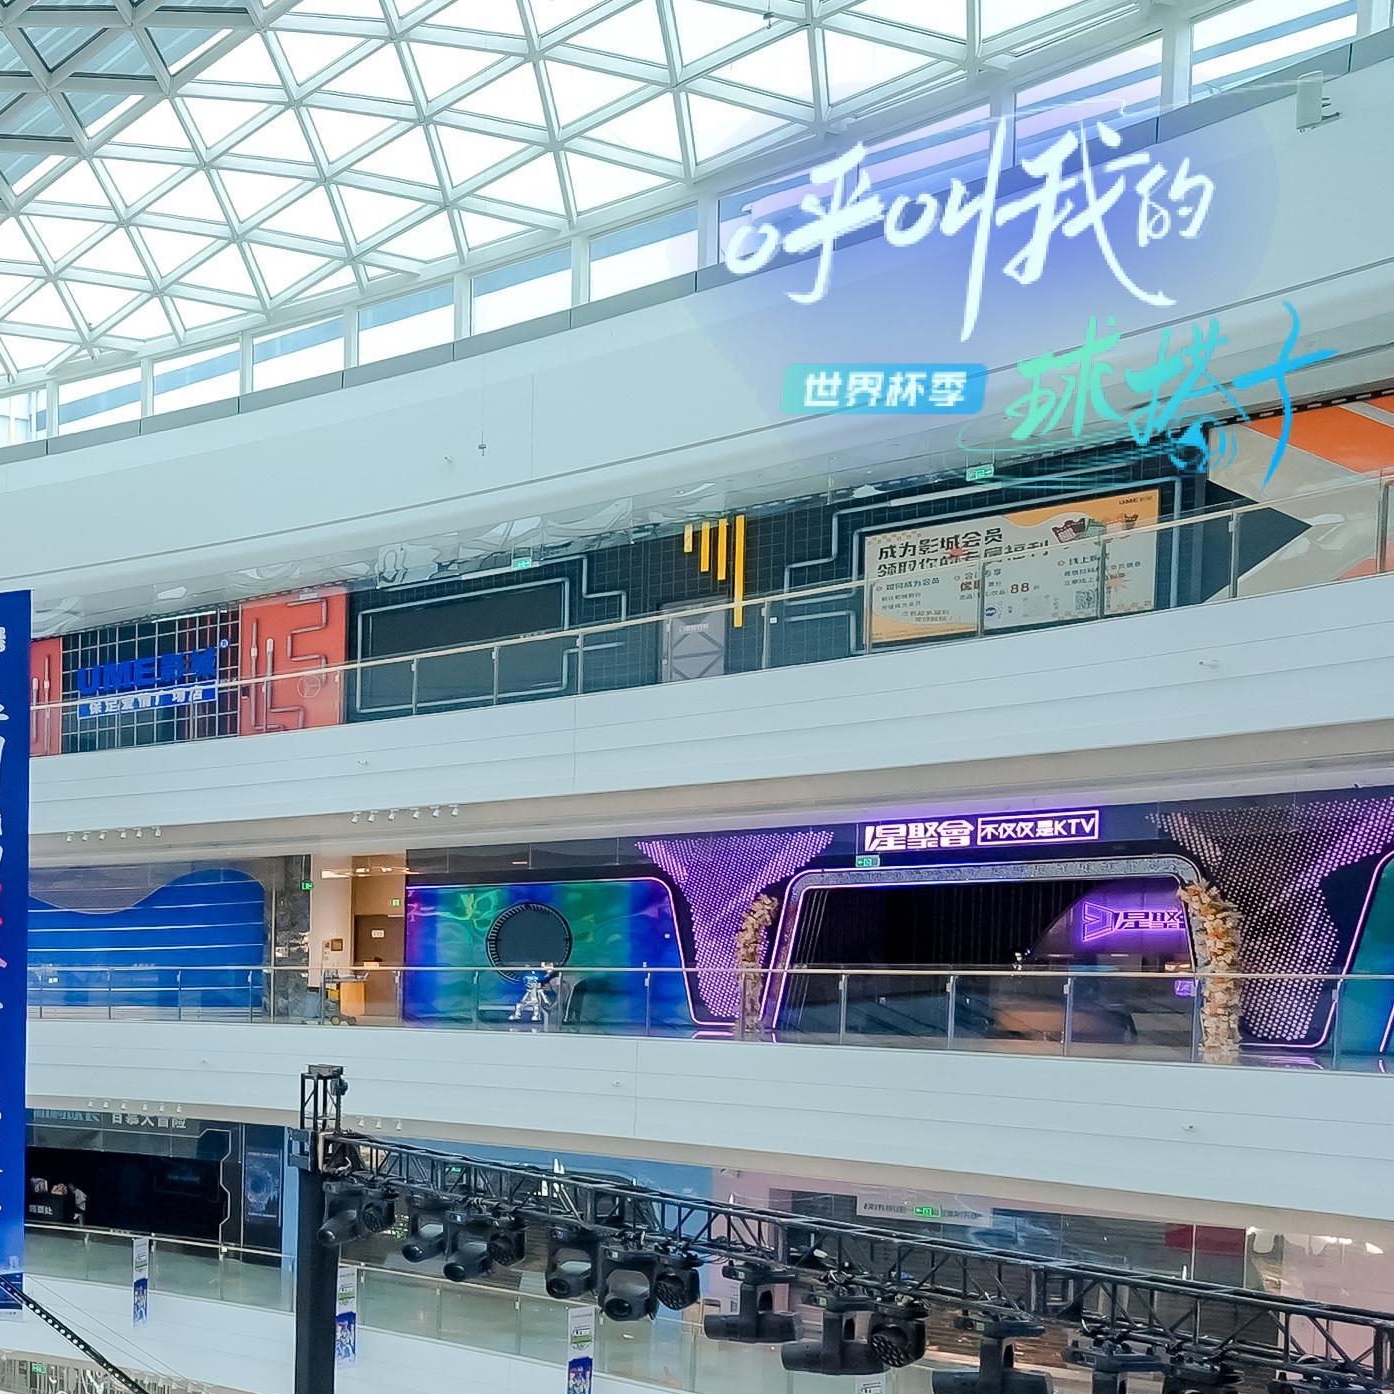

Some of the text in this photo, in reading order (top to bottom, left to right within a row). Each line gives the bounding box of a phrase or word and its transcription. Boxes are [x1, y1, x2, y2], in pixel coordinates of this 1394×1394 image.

[878, 527, 1004, 561] 成为影城会员
[980, 816, 1096, 841] 不仅仅是KTV
